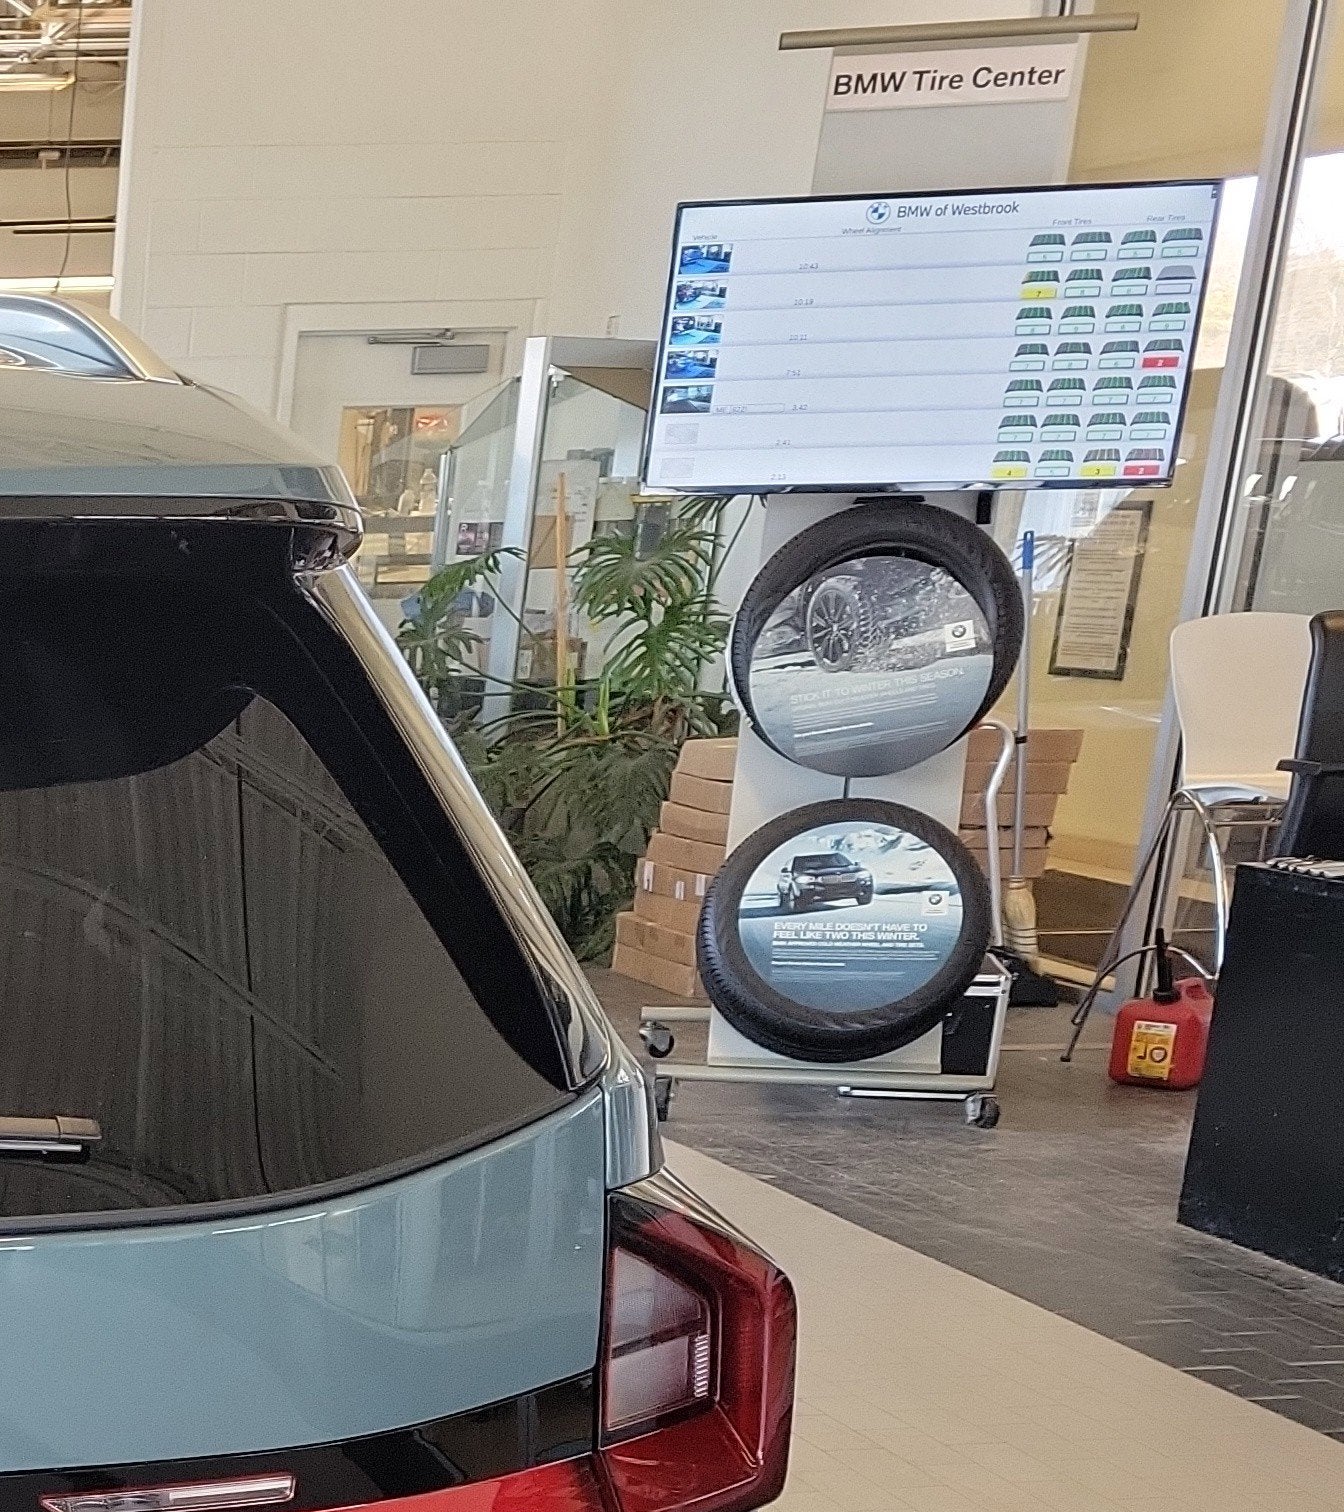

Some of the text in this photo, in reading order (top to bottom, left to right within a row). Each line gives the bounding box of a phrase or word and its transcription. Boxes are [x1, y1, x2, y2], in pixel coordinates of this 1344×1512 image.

[833, 65, 1066, 96] BMW Tire Center
[897, 201, 1020, 218] BMW of Westbrook
[775, 922, 928, 932] EVERY MILE DOESN'T HAVE TO
[773, 930, 920, 941] FEEL LIKE TWO THIS WINTER.
